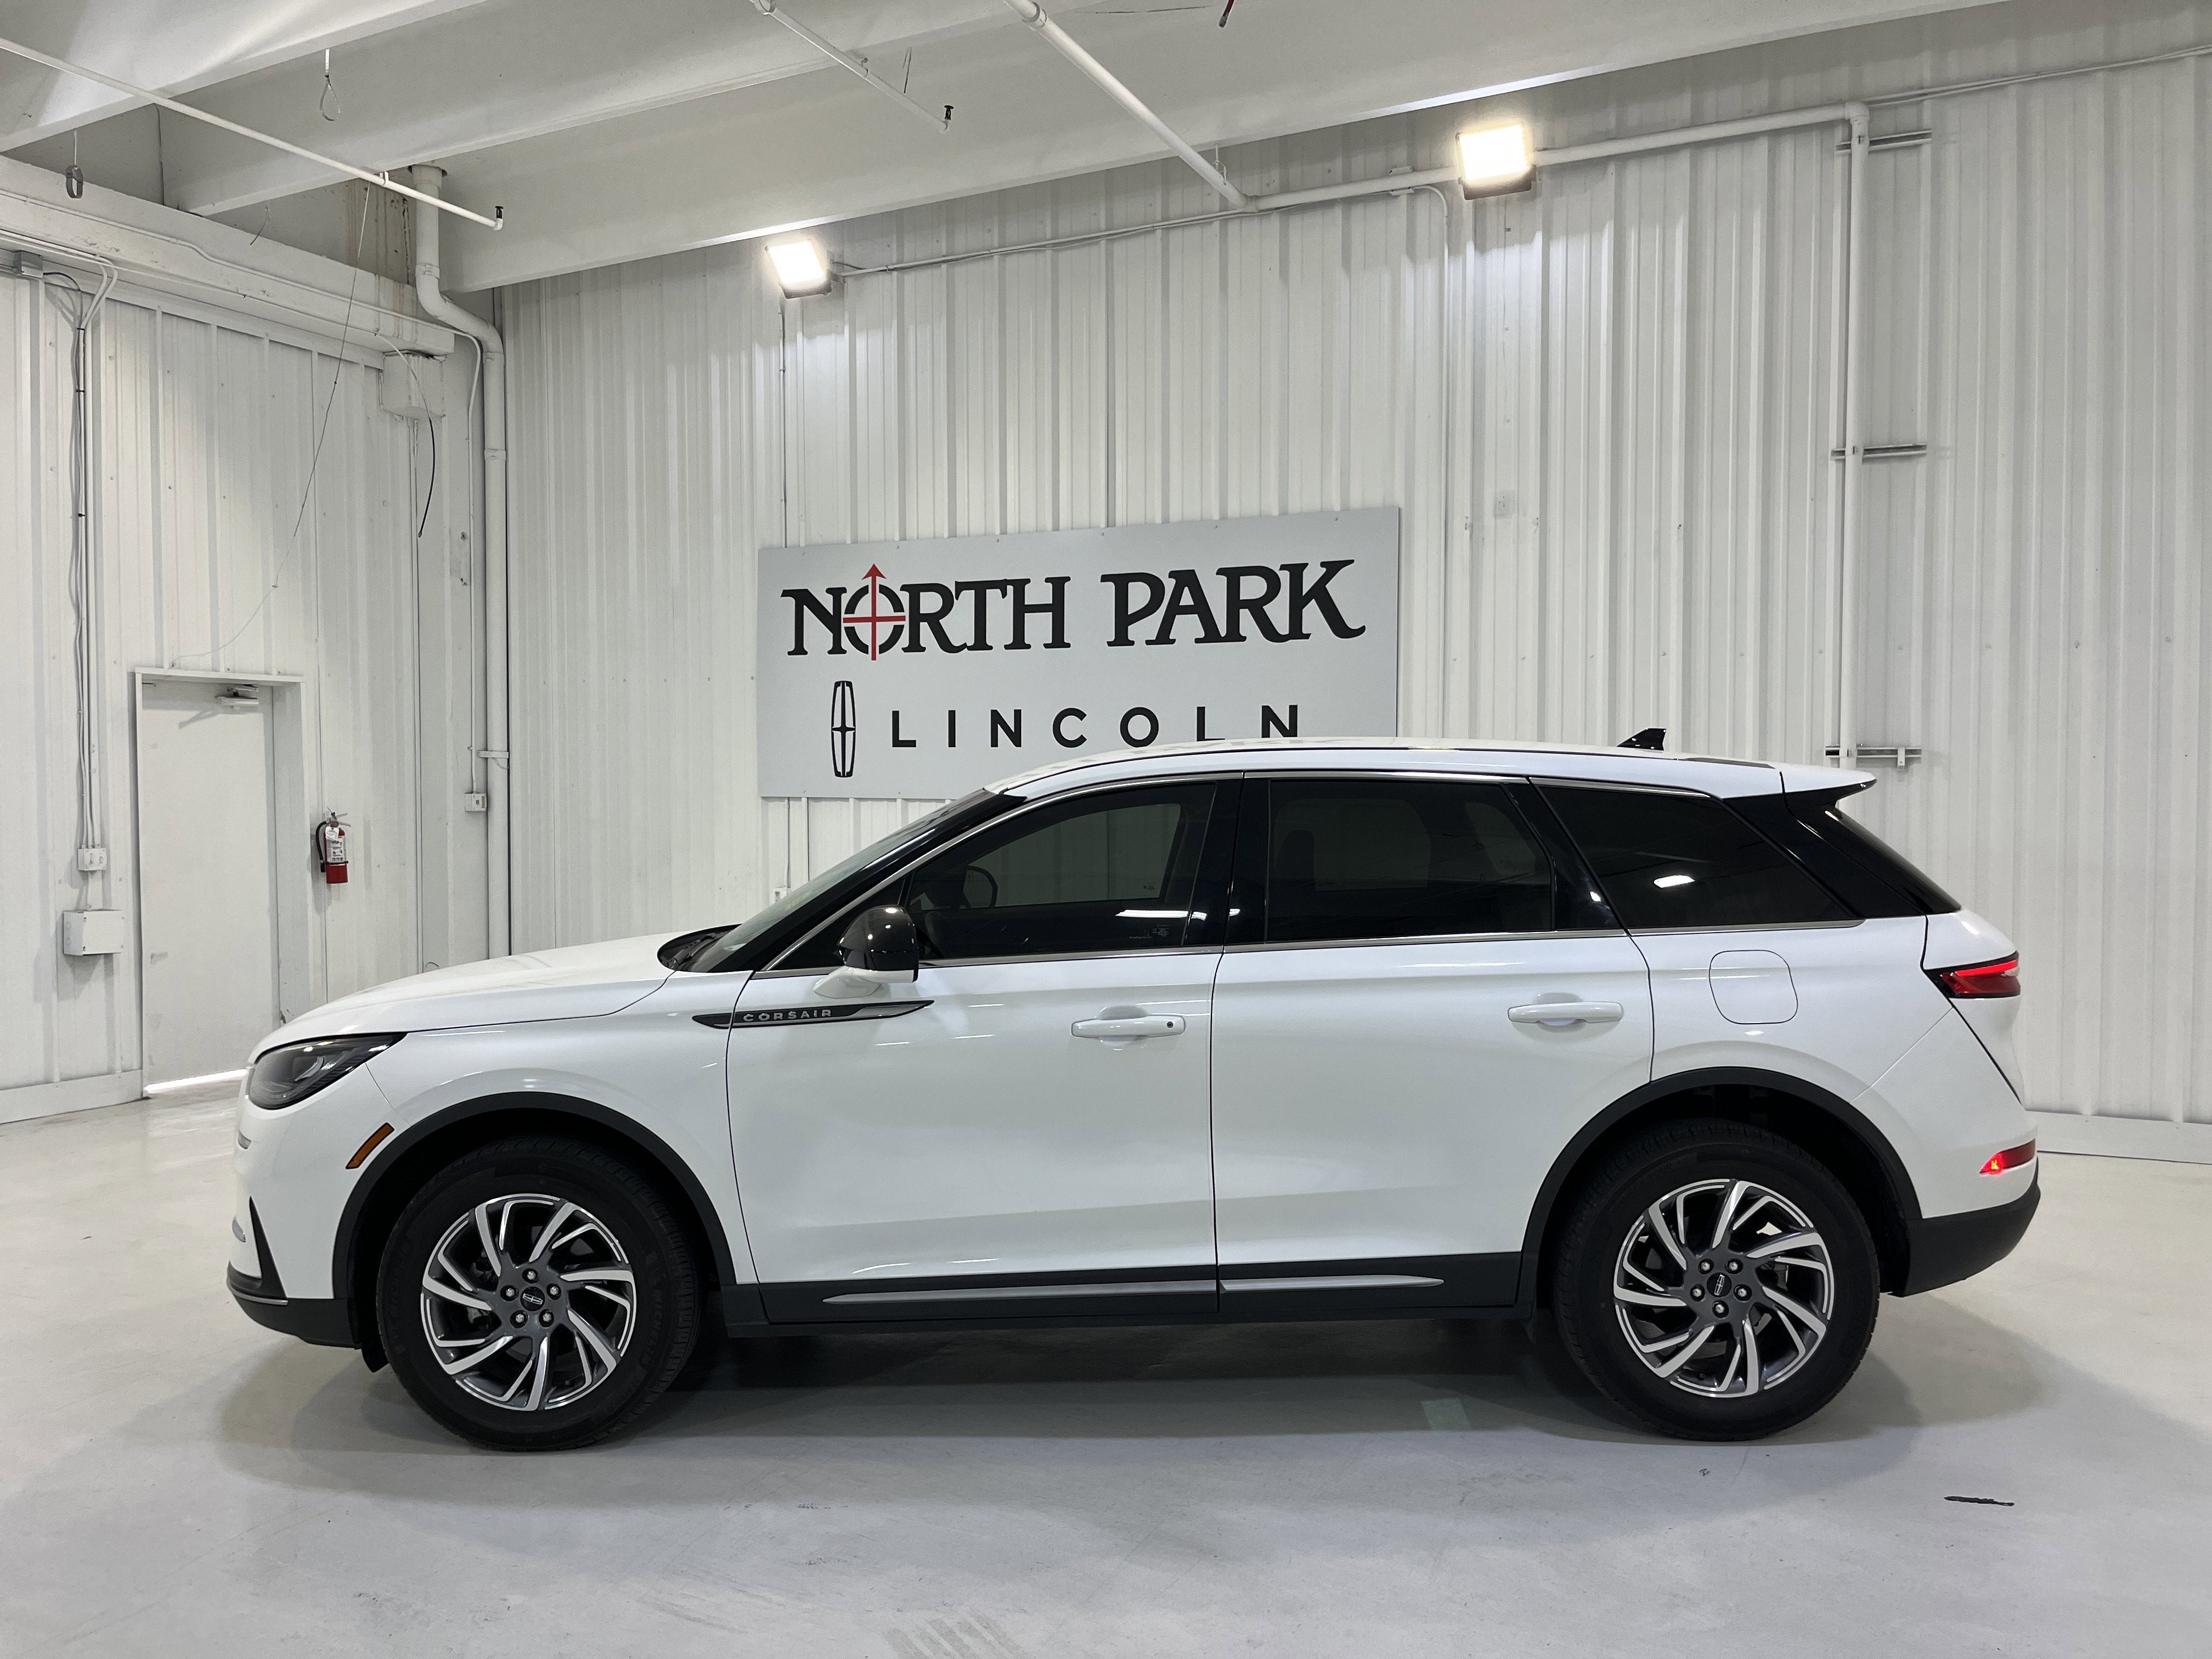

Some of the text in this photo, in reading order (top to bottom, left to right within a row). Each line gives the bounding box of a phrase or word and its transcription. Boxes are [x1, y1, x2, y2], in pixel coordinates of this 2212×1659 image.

[781, 559, 1366, 657] NORTH PARK
[891, 704, 1298, 748] LINCOLN
[743, 1009, 831, 1022] CORSAIR
